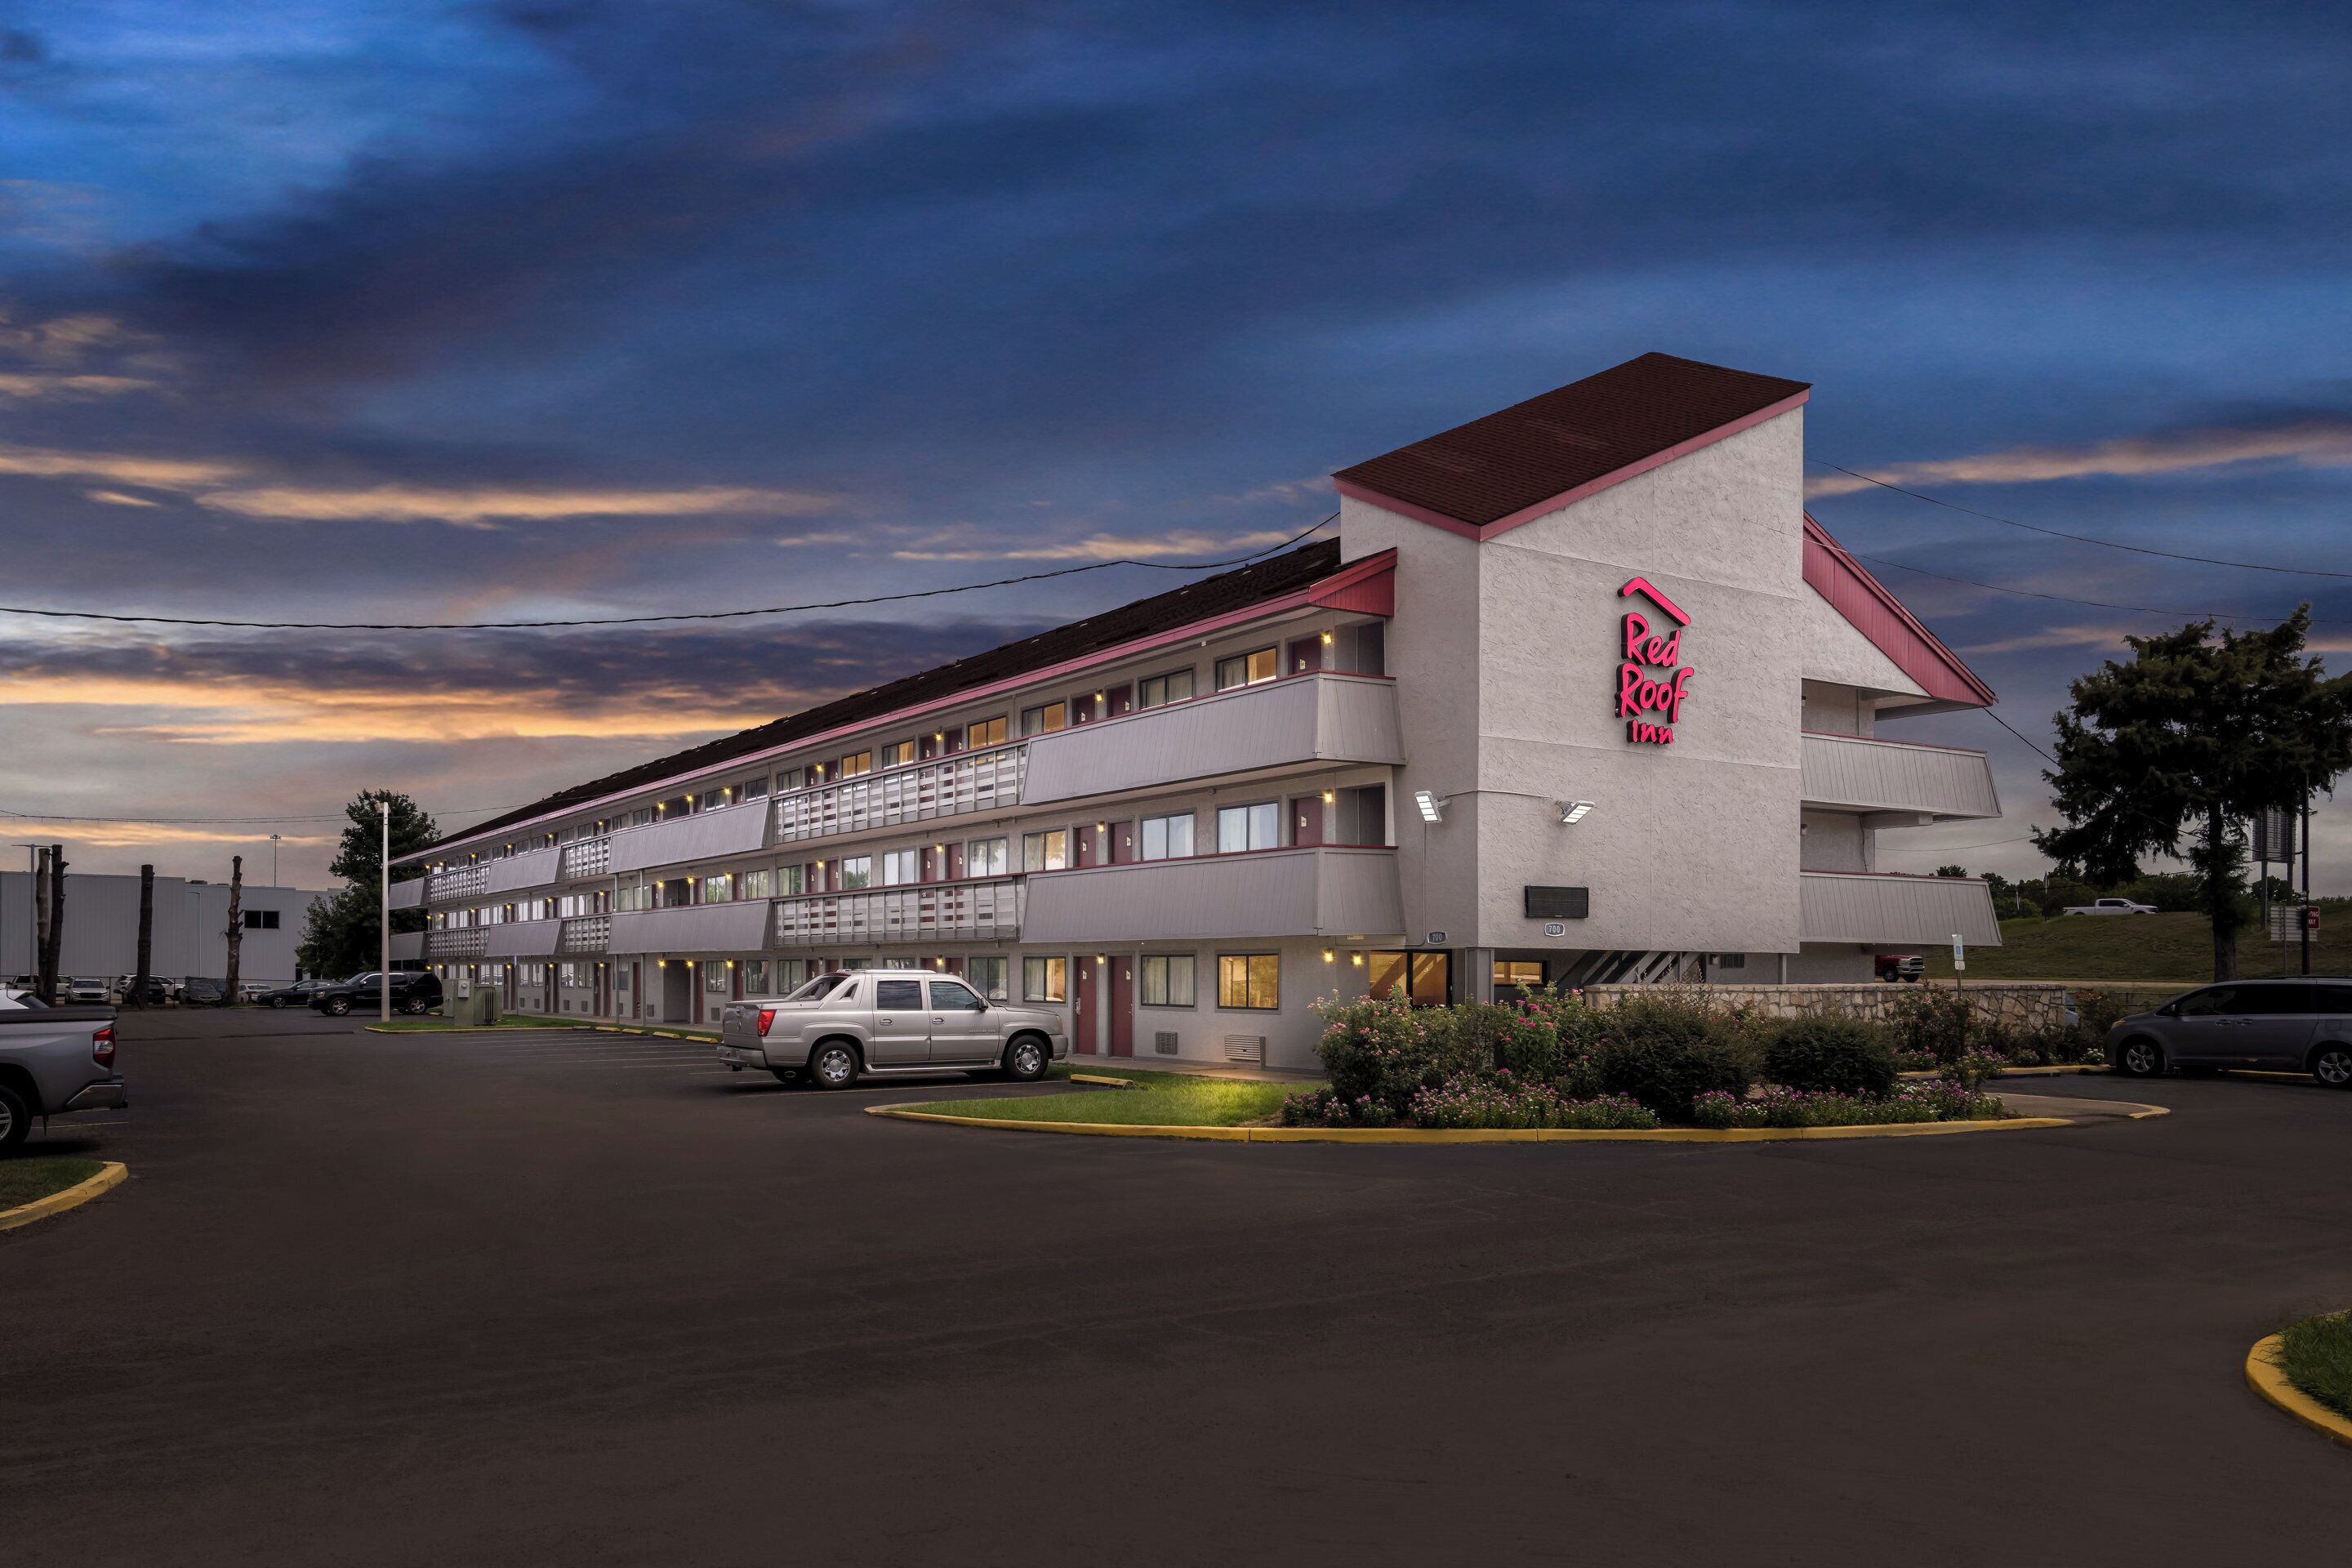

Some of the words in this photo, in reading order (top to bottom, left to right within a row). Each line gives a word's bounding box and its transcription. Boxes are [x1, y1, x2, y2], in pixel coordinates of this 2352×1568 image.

[1622, 612, 1681, 667] Red
[1616, 662, 1695, 724] Roof
[1432, 933, 1443, 942] 700
[1548, 925, 1561, 933] 700
